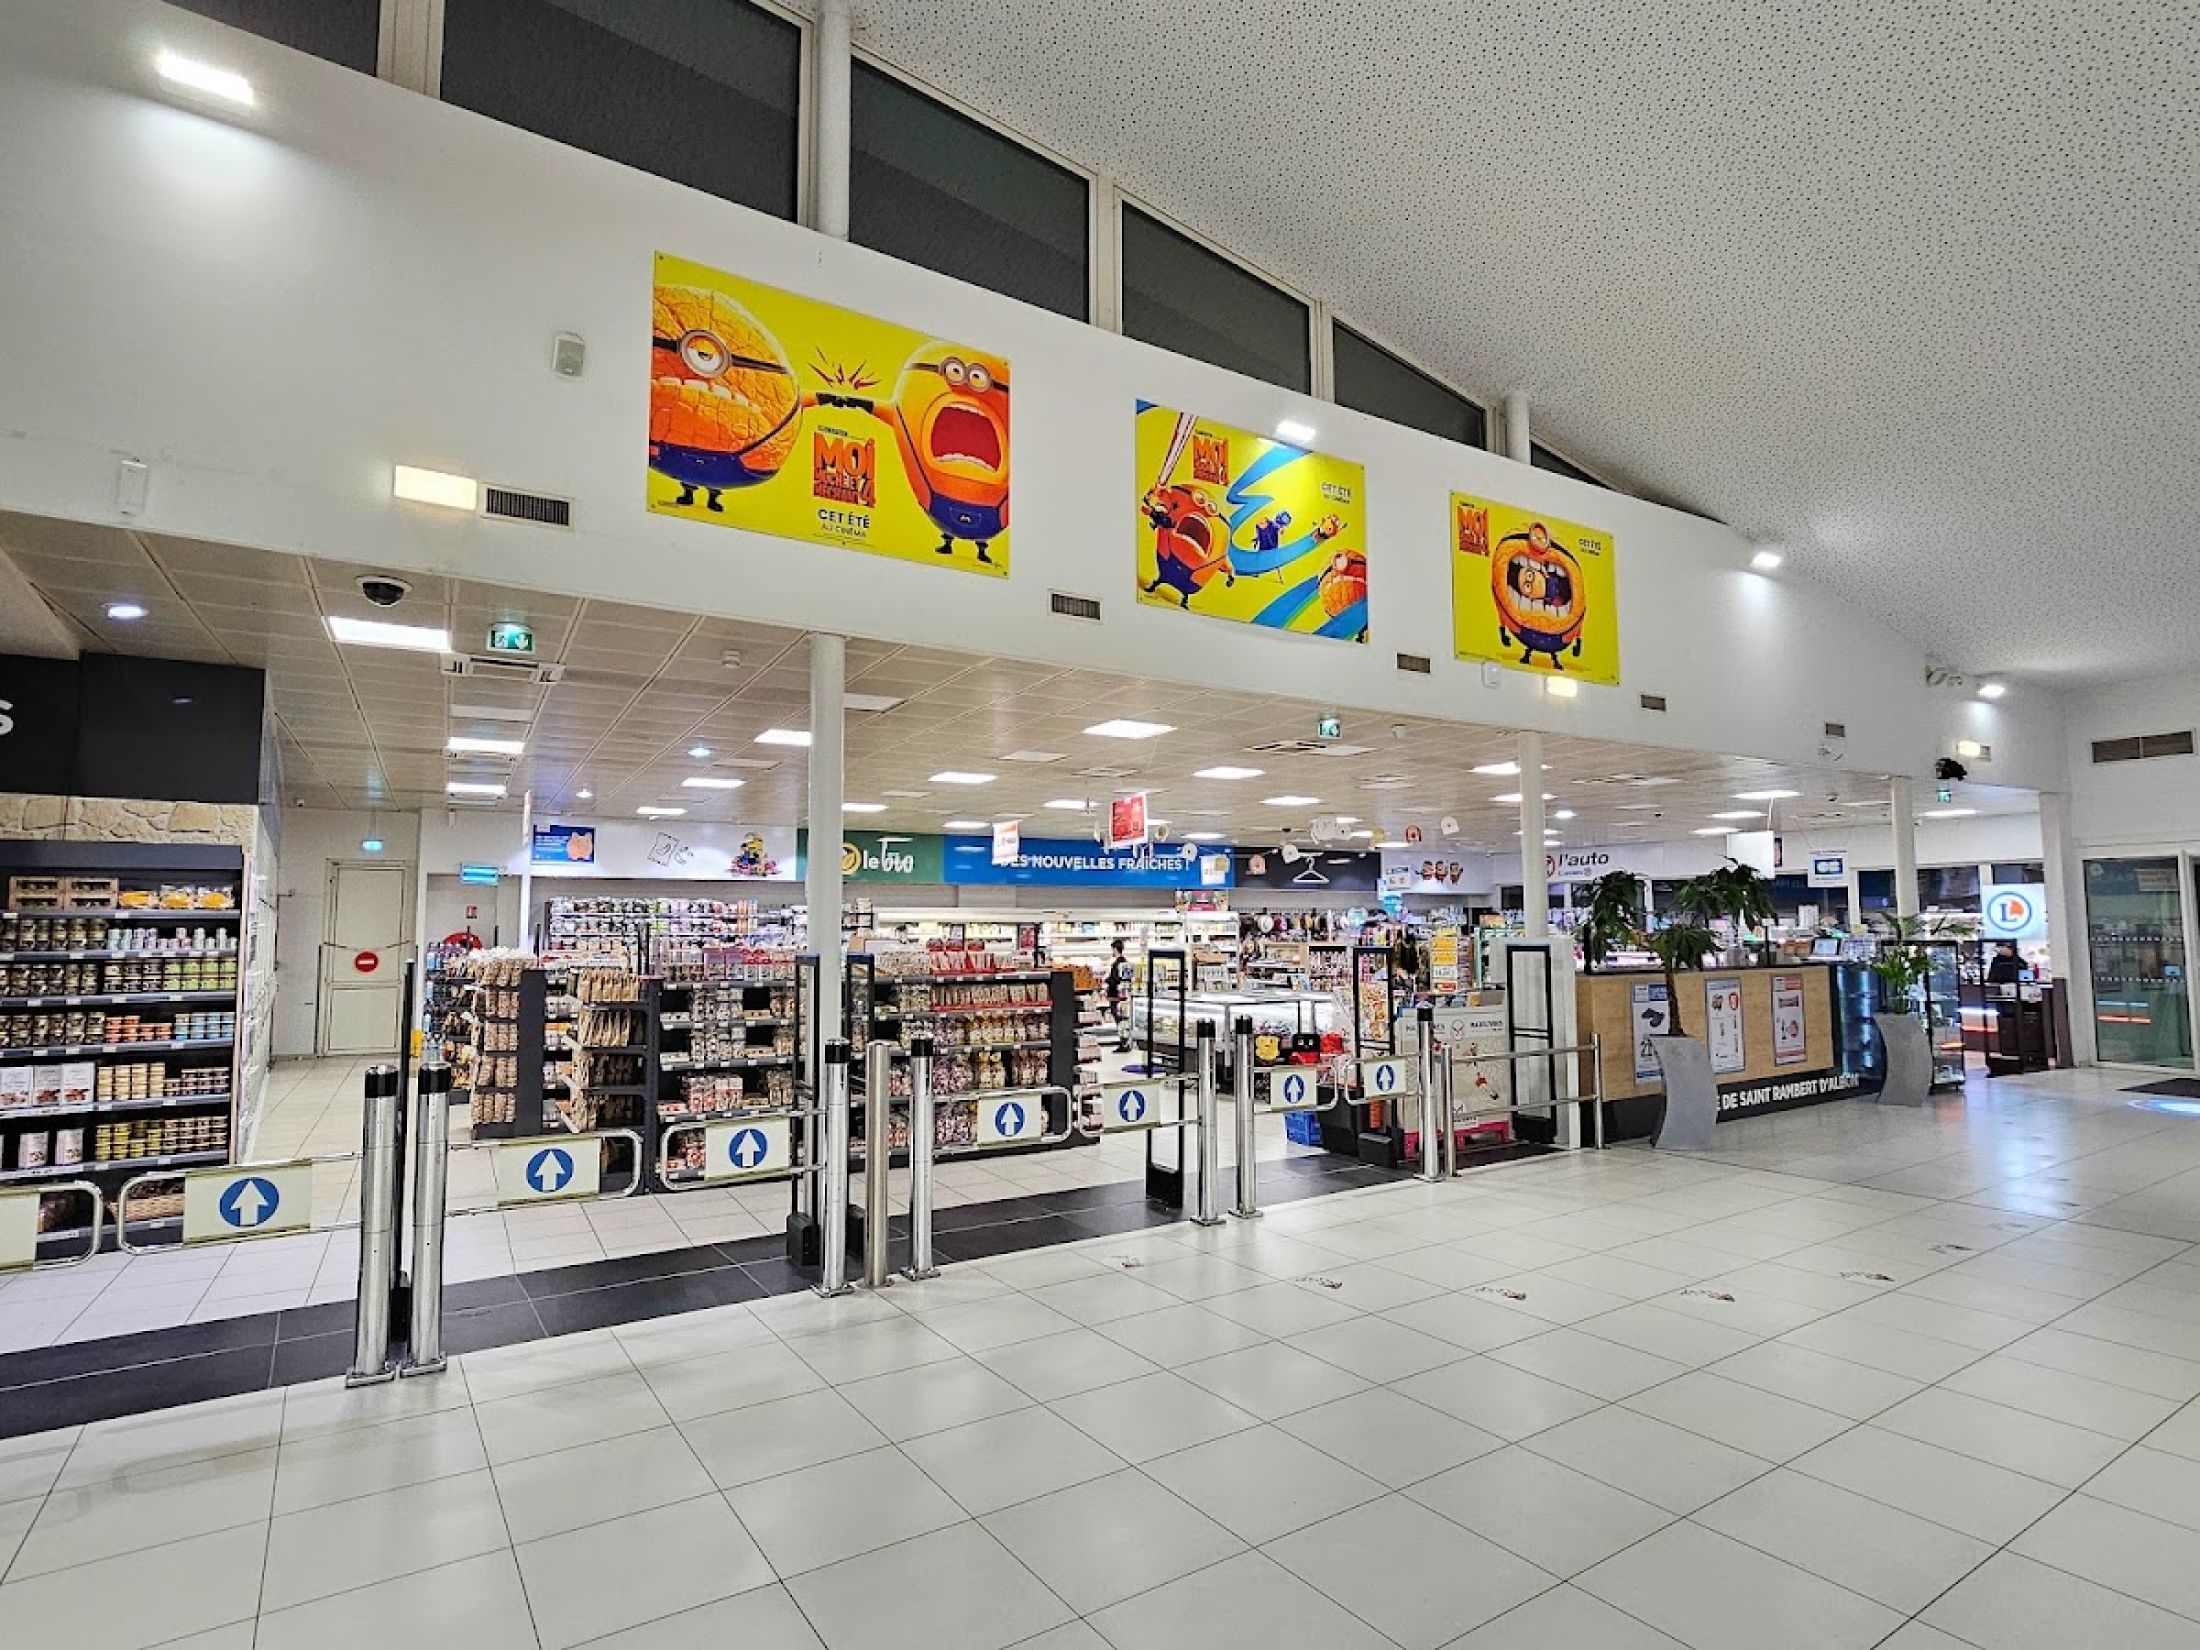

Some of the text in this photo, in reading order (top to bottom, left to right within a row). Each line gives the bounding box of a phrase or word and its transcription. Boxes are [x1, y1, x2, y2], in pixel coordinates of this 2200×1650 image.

[814, 431, 876, 481] MOI
[1193, 435, 1228, 466] MOI
[818, 509, 869, 529] CET ÉTÉ
[1457, 506, 1488, 540] MOI
[863, 840, 914, 874] le bio
[1031, 854, 1114, 872] NOUVELLES
[1559, 852, 1609, 867] l'auto
[1722, 1092, 1738, 1110] DE
[1739, 1086, 1771, 1107] SAINT
[1772, 1079, 1818, 1101] RAMBERT
